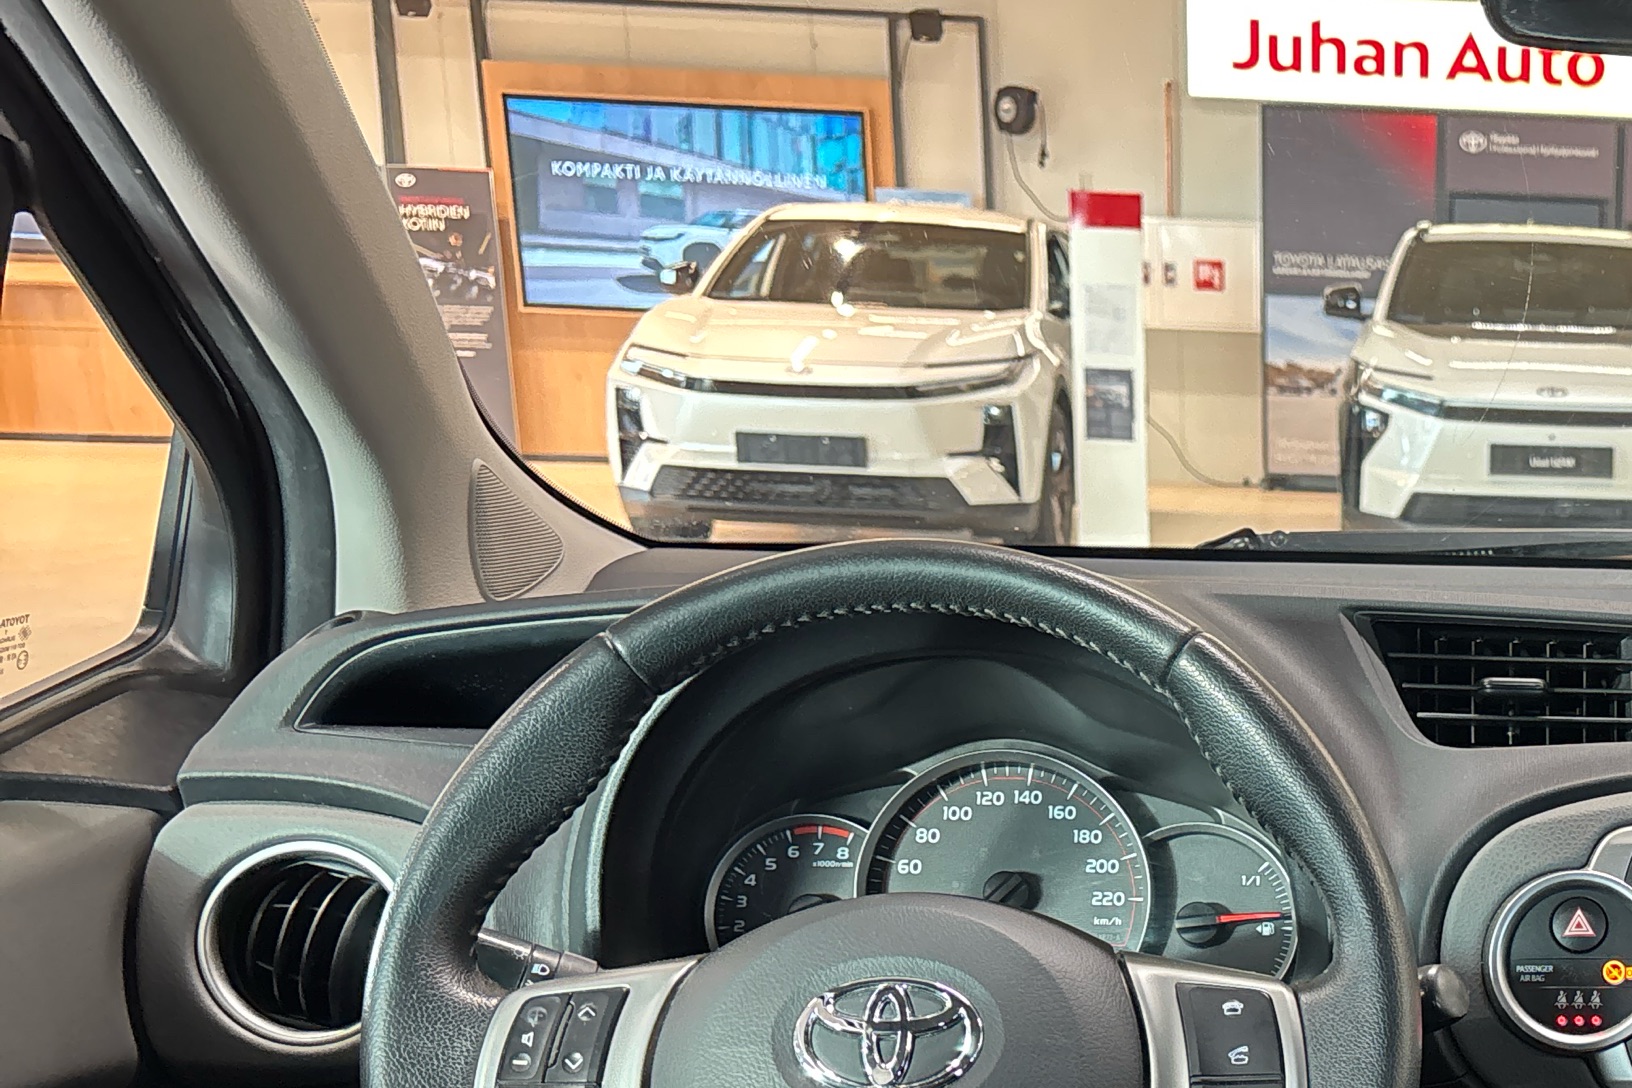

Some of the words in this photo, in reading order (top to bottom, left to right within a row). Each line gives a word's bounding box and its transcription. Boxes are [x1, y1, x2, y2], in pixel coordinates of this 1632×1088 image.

[1232, 19, 1429, 79] Juhan
[1446, 33, 1605, 86] Auto
[551, 160, 641, 179] KOMPAKTI
[645, 165, 666, 181] JA
[976, 790, 1005, 806] 120
[1013, 789, 1043, 805] 140
[942, 806, 973, 821] 100
[1048, 805, 1077, 820] 160
[915, 828, 941, 844] 80
[1073, 828, 1103, 844] 180
[787, 845, 800, 859] 6
[812, 842, 825, 855] 7
[836, 847, 850, 860] 8
[765, 857, 778, 871] 5
[897, 860, 922, 875] 60
[1085, 858, 1120, 874] 200
[744, 873, 757, 887] 4
[1241, 874, 1261, 887] 1/1
[736, 895, 748, 908] 3
[1091, 891, 1126, 907] 220
[734, 919, 746, 933] 2
[1093, 916, 1122, 926] km/h
[1516, 965, 1554, 973] PASSENGER
